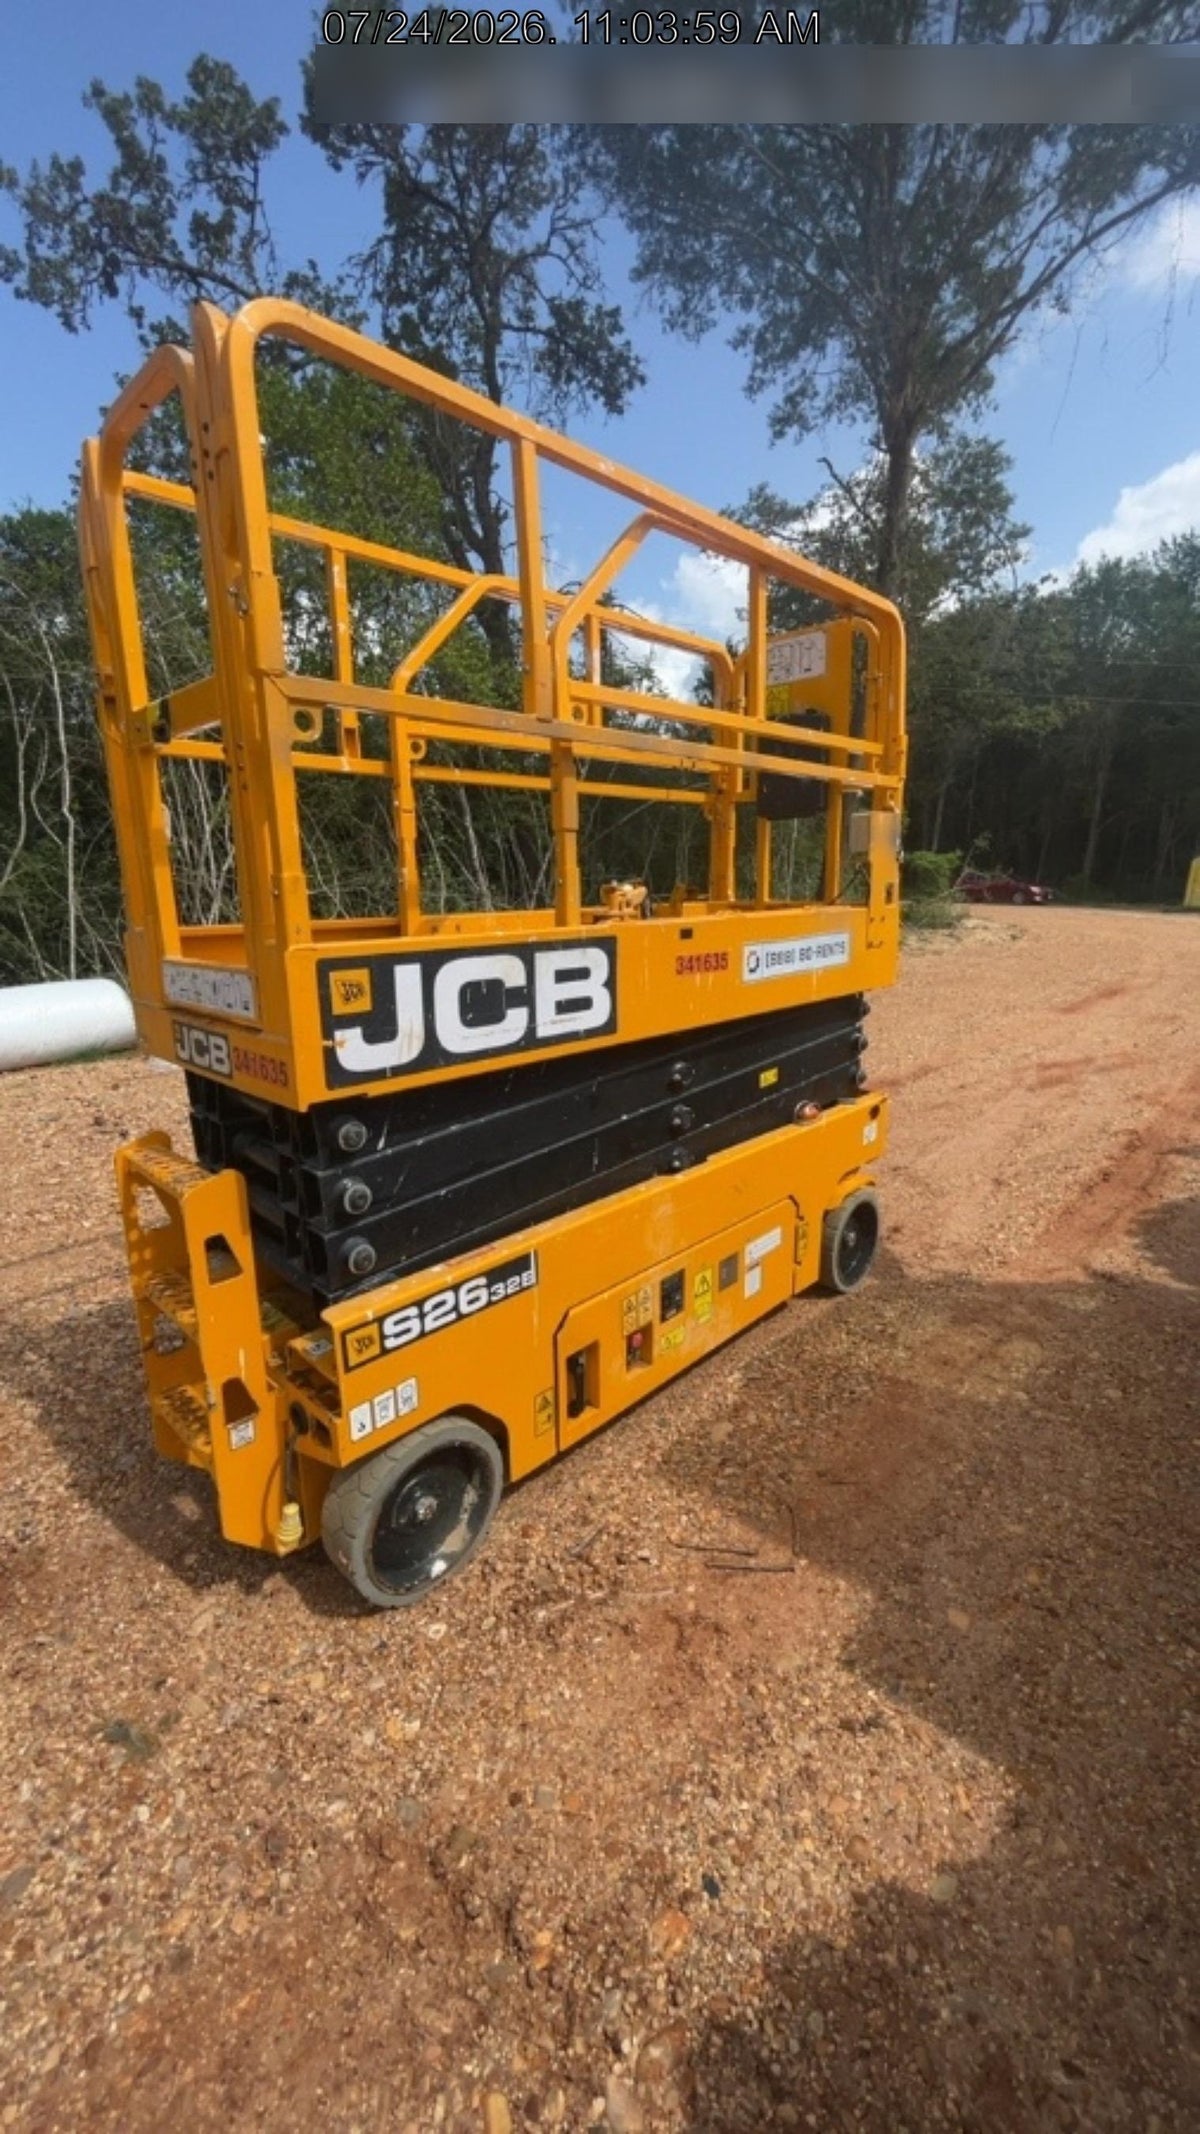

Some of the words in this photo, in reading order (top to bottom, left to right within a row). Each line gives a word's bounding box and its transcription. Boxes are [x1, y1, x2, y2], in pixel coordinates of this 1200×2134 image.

[676, 952, 729, 976] 341635
[334, 946, 612, 1074] JCB
[175, 1023, 232, 1075] JCB
[232, 1045, 289, 1087] 341635
[381, 1275, 489, 1350] S26
